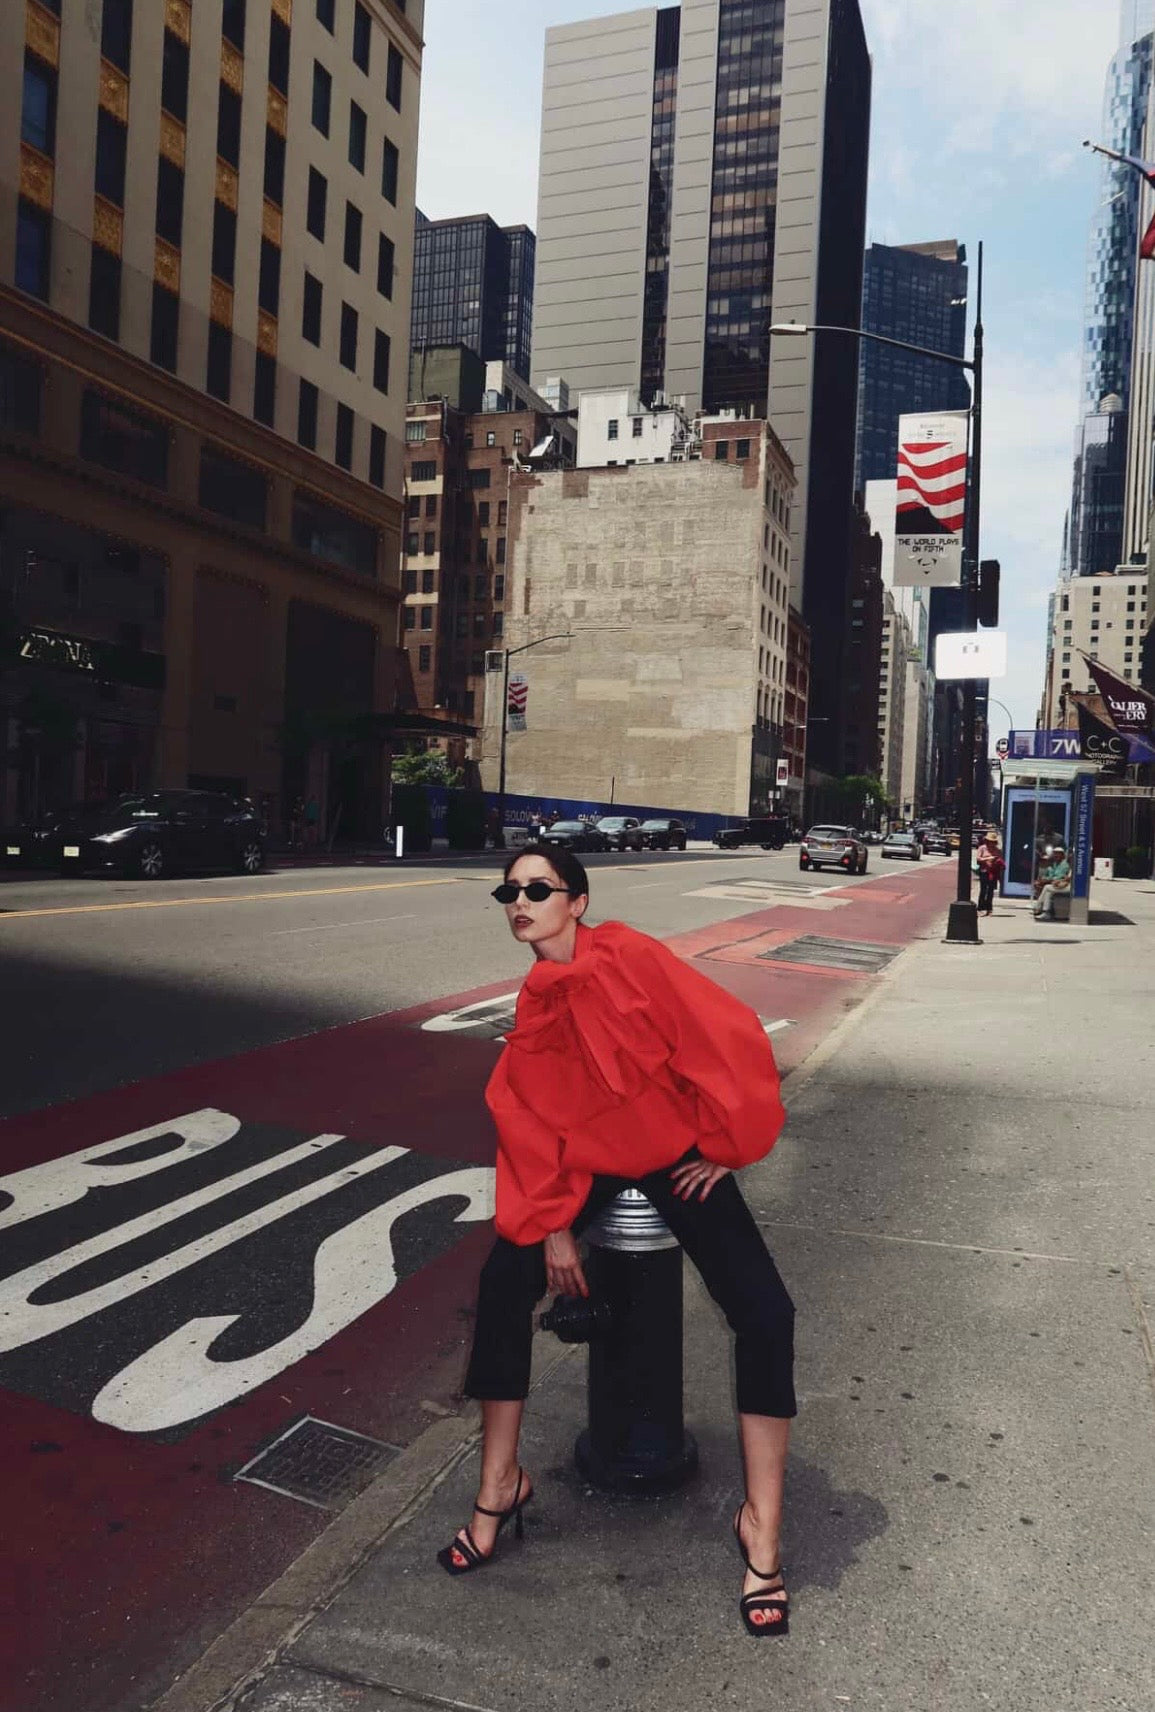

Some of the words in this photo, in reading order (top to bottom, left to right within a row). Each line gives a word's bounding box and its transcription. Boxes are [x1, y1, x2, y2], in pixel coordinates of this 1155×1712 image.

[898, 538, 911, 546] THE
[914, 538, 936, 546] WORLD
[912, 545, 921, 553] ON
[924, 545, 944, 553] FIFTH
[1080, 784, 1089, 803] West
[1079, 814, 1088, 835] Street
[1076, 849, 1086, 875] Avenue
